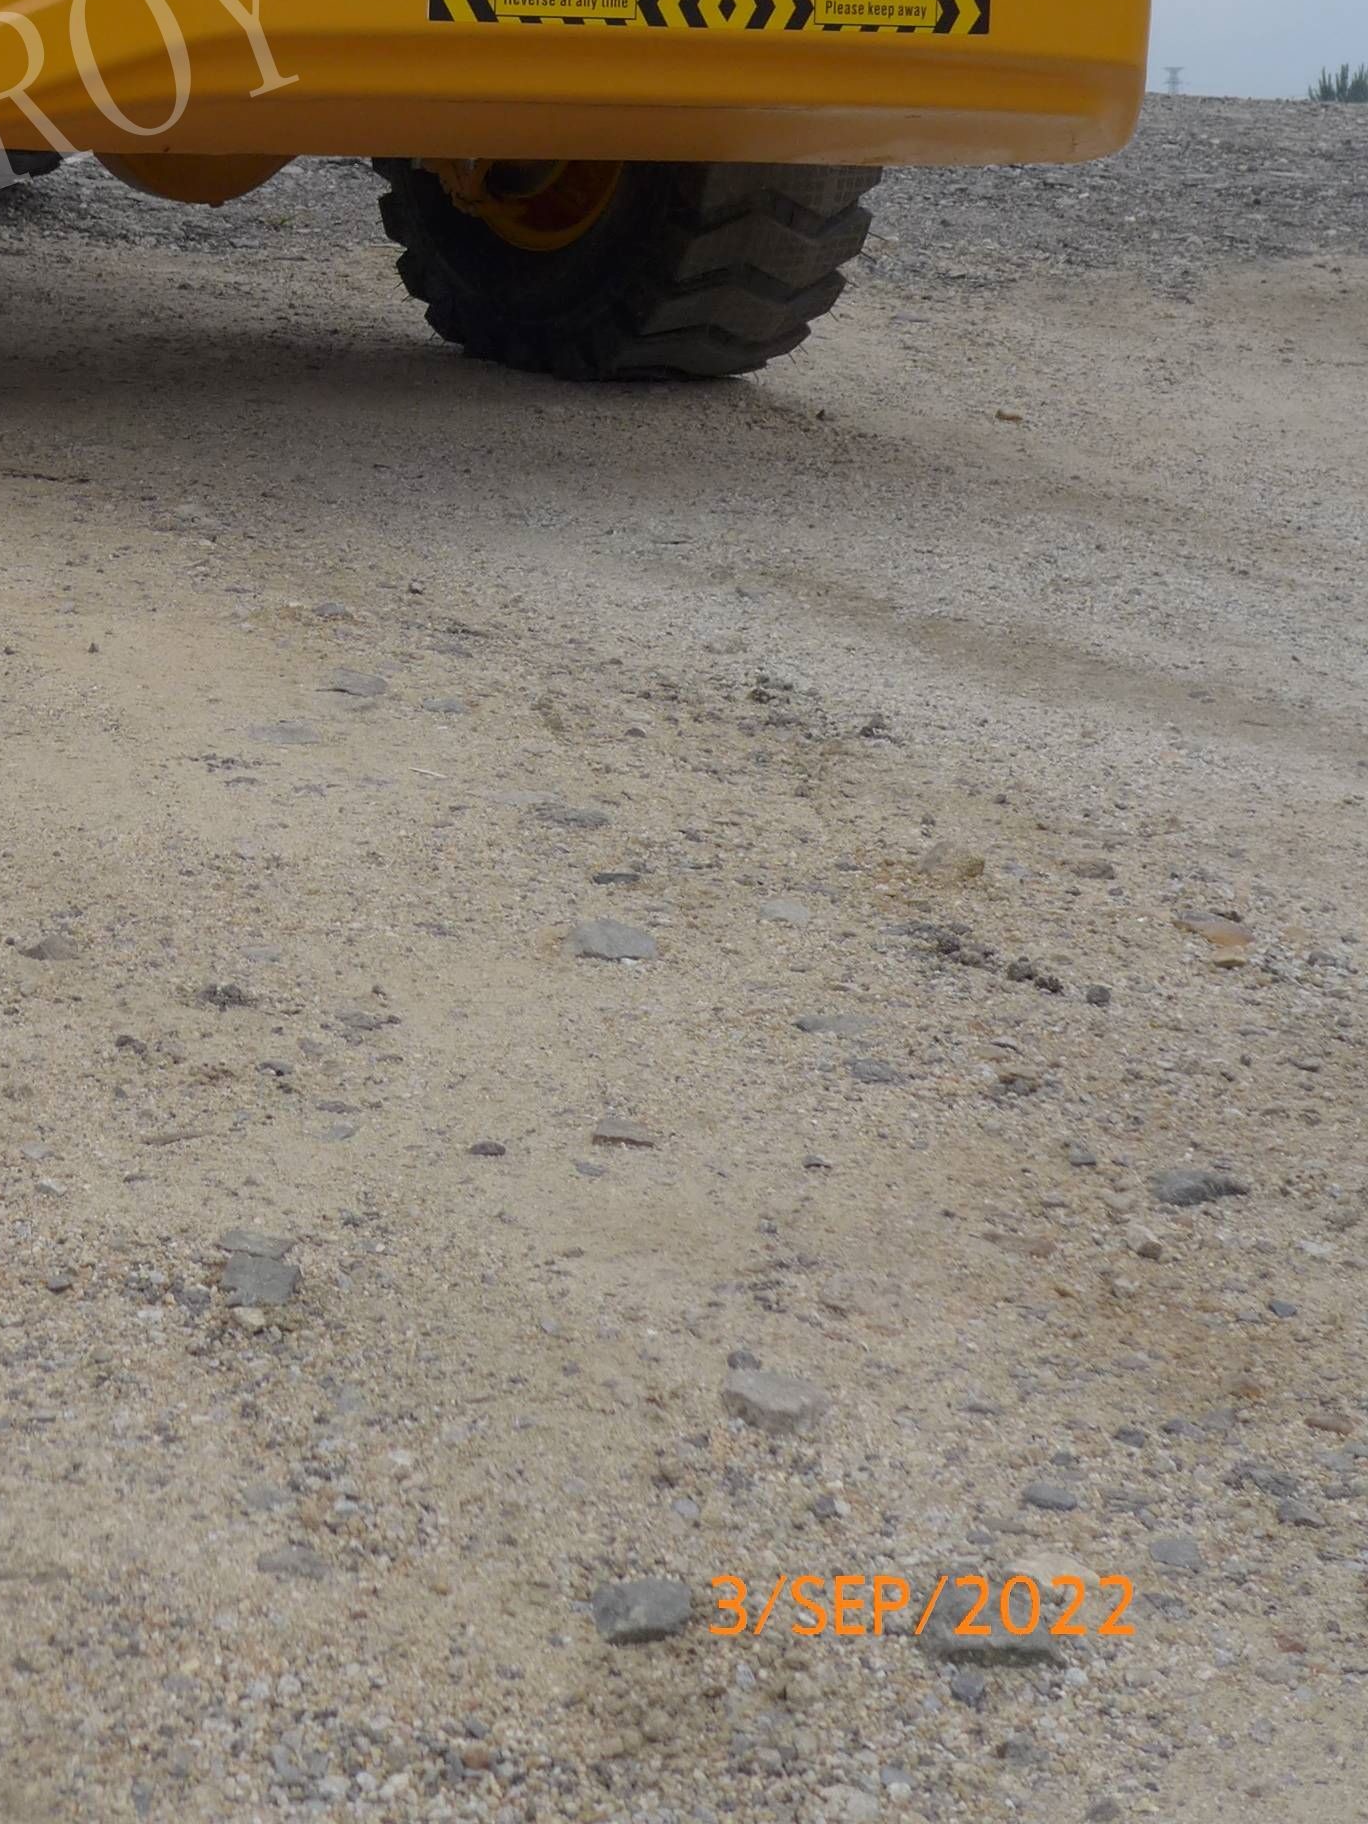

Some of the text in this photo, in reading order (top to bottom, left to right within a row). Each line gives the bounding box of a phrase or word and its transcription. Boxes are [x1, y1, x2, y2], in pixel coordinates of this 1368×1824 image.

[825, 0, 928, 20] Please keep away
